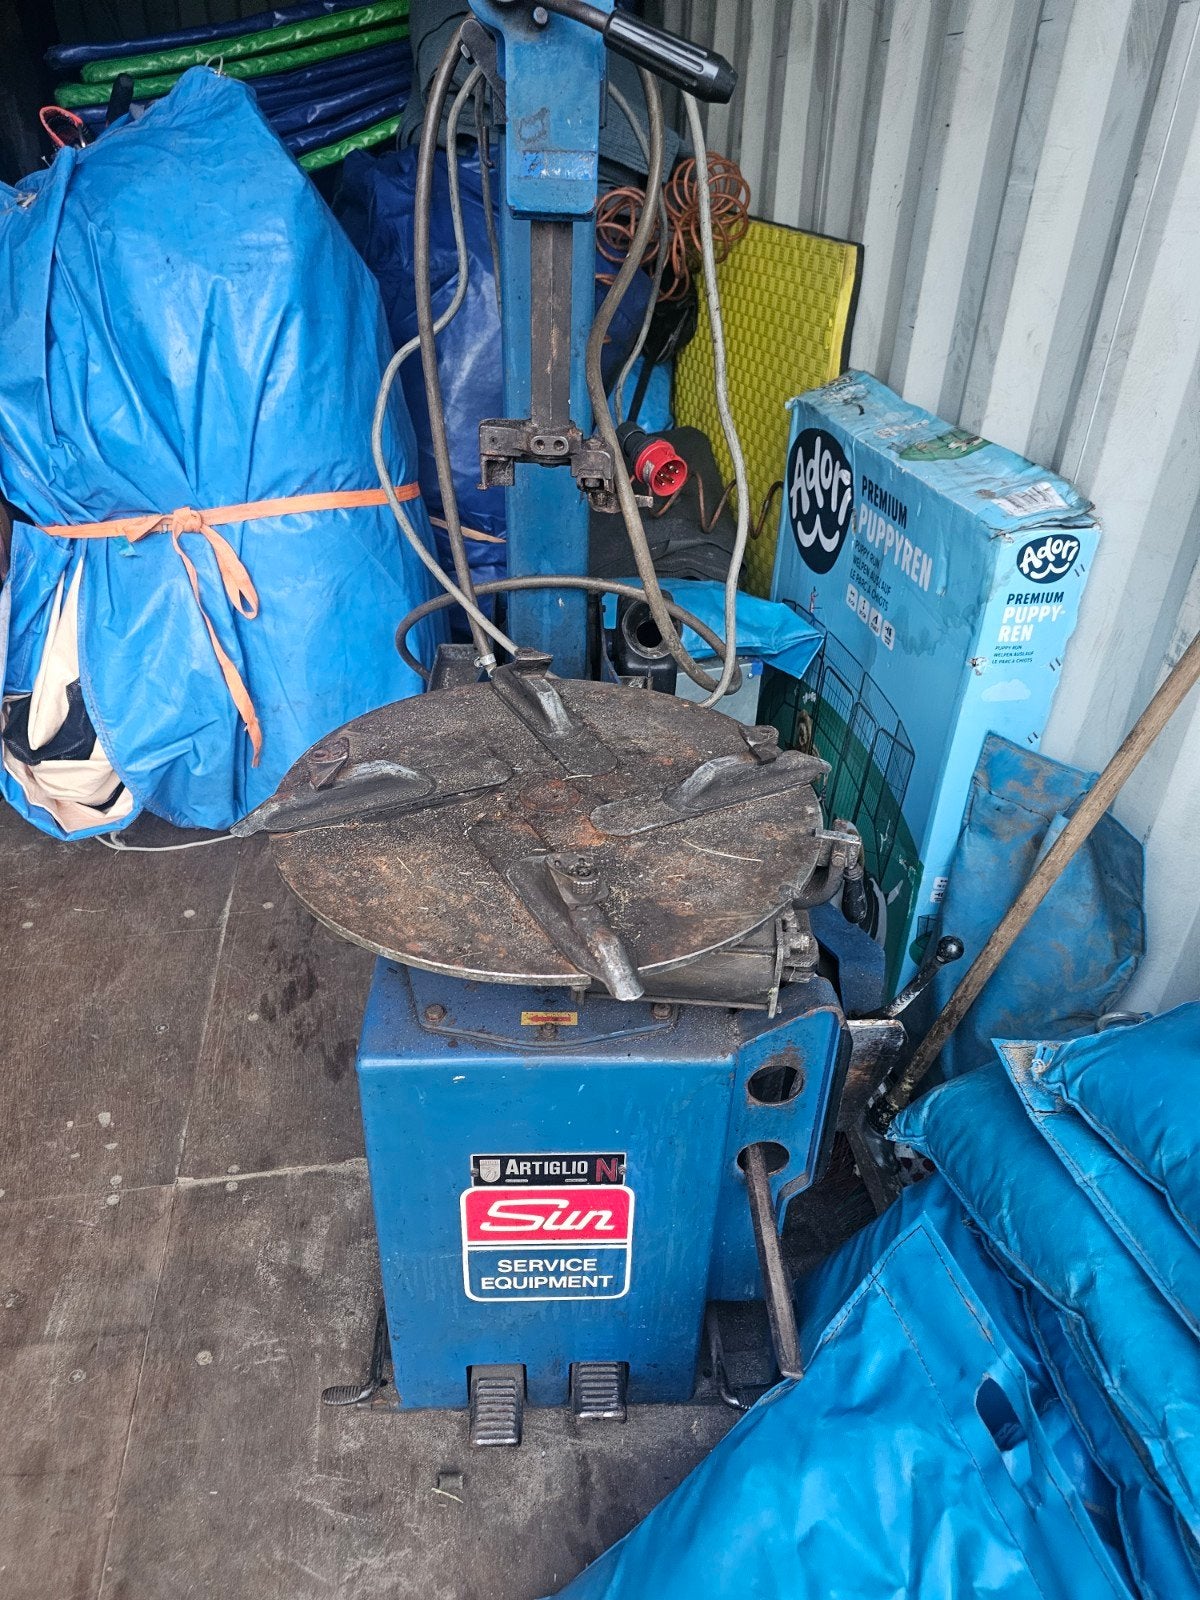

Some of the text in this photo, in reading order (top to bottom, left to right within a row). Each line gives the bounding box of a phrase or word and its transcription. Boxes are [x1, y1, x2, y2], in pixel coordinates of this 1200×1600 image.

[789, 436, 852, 526] Adori
[862, 474, 908, 530] PREMIUM
[858, 502, 933, 592] PUPPYREN
[1020, 537, 1079, 575] Adori
[1006, 591, 1065, 605] PREMIUM
[1001, 604, 1067, 624] PUPPY-
[997, 624, 1034, 643] REN
[595, 1157, 619, 1183] N
[479, 1198, 616, 1232] Sun
[497, 1258, 598, 1273] SERVICE
[481, 1274, 614, 1290] EQUIPMENT
